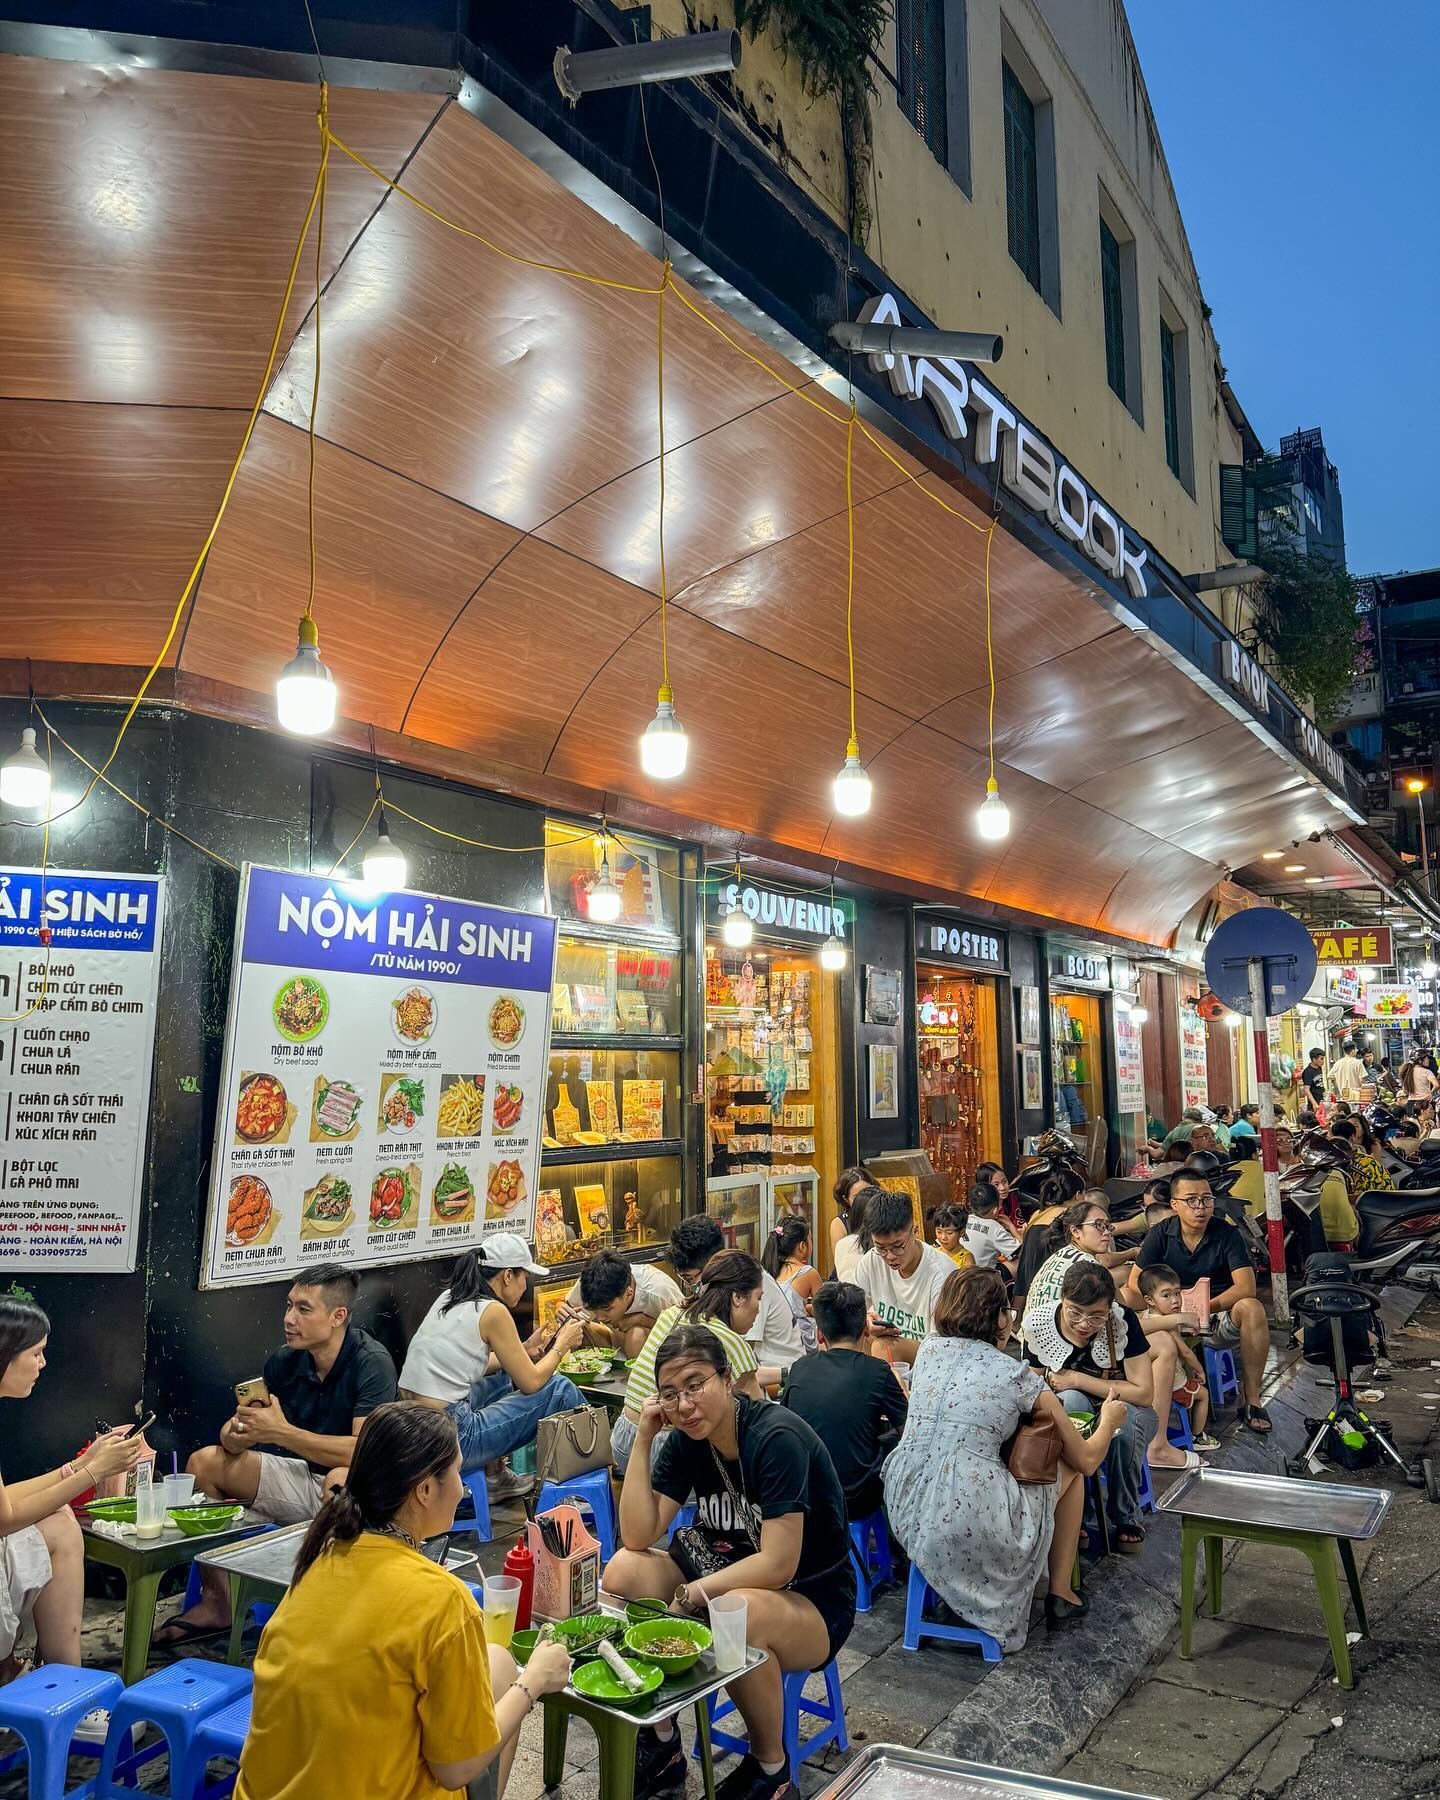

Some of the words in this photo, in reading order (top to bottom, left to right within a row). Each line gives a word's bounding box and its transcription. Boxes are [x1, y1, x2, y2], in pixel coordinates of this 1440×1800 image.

[1229, 640, 1270, 714] BOOK
[46, 889, 148, 924] SINH
[724, 884, 845, 938] SOUVENIR
[278, 888, 377, 949] NỘM
[387, 904, 450, 952] HẢI
[457, 921, 533, 963] SINH
[4, 926, 25, 935] 1990
[57, 927, 79, 938] HIỆU
[81, 927, 107, 938] SÁCH
[108, 929, 124, 939] BỜ
[935, 926, 999, 961] POSTER
[1313, 932, 1378, 958] AFÉ
[29, 963, 46, 976] BÒ
[49, 964, 75, 977] KHÔ
[396, 954, 425, 972] NĂM
[426, 957, 463, 975] 1990/
[27, 981, 60, 994] CHIM
[63, 981, 86, 995] CÚT
[89, 982, 123, 996] CHIÊN
[26, 998, 57, 1013] THẬP
[60, 996, 88, 1012] CẨM
[91, 999, 108, 1012] BÒ
[112, 1001, 144, 1013] CHIM
[24, 1026, 55, 1041] CUỐN
[59, 1029, 90, 1044] CHẠO
[22, 1046, 54, 1058] CHUA
[57, 1046, 71, 1058] LÁ
[271, 1044, 291, 1057] NỘM
[293, 1044, 305, 1056] BÒ
[306, 1045, 323, 1057] KHÔ
[387, 1049, 403, 1061] NỘM
[405, 1048, 421, 1061] THẬP
[422, 1048, 437, 1060] CẨM
[273, 1057, 285, 1067] Dry
[286, 1057, 301, 1065] beef
[301, 1058, 319, 1066] salad
[488, 1053, 503, 1063] NỘM
[504, 1053, 520, 1063] CHIM
[20, 1063, 54, 1075] CHUA
[55, 1063, 80, 1076] RÁN
[18, 1092, 50, 1106] CHÂN
[53, 1093, 70, 1106] GÀ
[72, 1092, 96, 1107] SỐT
[98, 1094, 124, 1107] THÁI
[16, 1111, 54, 1123] KHOAI
[58, 1110, 80, 1123] TÂY
[82, 1111, 116, 1124] CHIÊN
[15, 1127, 39, 1140] XÚC
[42, 1127, 70, 1140] XÍCH
[72, 1128, 97, 1141] RÁN
[316, 1147, 333, 1157] NEM
[334, 1145, 353, 1156] CUỐN
[378, 1144, 394, 1153] NEM
[394, 1142, 408, 1152] RÁN
[409, 1142, 423, 1153] THỊT
[436, 1141, 453, 1151] KHOAI
[453, 1141, 465, 1150] TÂY
[465, 1140, 480, 1149] CHIÊN
[231, 1149, 251, 1160] CHÂN
[252, 1148, 263, 1159] GÀ
[264, 1147, 279, 1159] SỐT
[280, 1148, 295, 1158] THÁI
[402, 1153, 417, 1161] spring
[11, 1158, 36, 1174] BỘT
[38, 1161, 59, 1175] LỌC
[244, 1161, 259, 1169] style
[259, 1160, 281, 1168] chicken
[330, 1157, 345, 1165] spring
[9, 1175, 26, 1188] GÀ
[56, 1178, 79, 1189] MAI
[22, 1199, 45, 1209] TRÊN
[47, 1199, 67, 1209] ỨNG
[70, 1201, 99, 1211] DỤNG:
[41, 1212, 76, 1220] BEFOOD,
[25, 1223, 42, 1233] HỘI
[44, 1224, 69, 1233] NGHỊ
[76, 1224, 98, 1232] SINH
[100, 1224, 127, 1234] NHẬT
[432, 1229, 446, 1238] NEM
[447, 1227, 462, 1236] CHUA
[462, 1225, 470, 1234] LÁ
[482, 1221, 498, 1231] BÁNH
[498, 1220, 505, 1229] GÀ
[30, 1235, 59, 1245] HOÀN
[61, 1234, 87, 1246] KIẾM,
[89, 1235, 103, 1245] HÀ
[105, 1235, 122, 1246] NỘI
[367, 1235, 384, 1245] CHIM
[385, 1232, 399, 1243] CÚT
[399, 1230, 416, 1241] CHIÊN
[29, 1248, 87, 1256] 0339095725
[302, 1242, 321, 1253] BÁNH
[323, 1240, 338, 1252] BỘT
[338, 1238, 351, 1250] LỌC
[386, 1244, 399, 1252] quail
[225, 1251, 243, 1262] NEM
[245, 1248, 265, 1260] CHUA
[266, 1245, 283, 1257] RÁN
[296, 1253, 317, 1262] Tapioca
[332, 1249, 355, 1258] dumpling
[220, 1263, 235, 1271] Fried
[235, 1259, 265, 1269] fermented
[265, 1258, 278, 1266] pork
[878, 1301, 926, 1333] BOSTON
